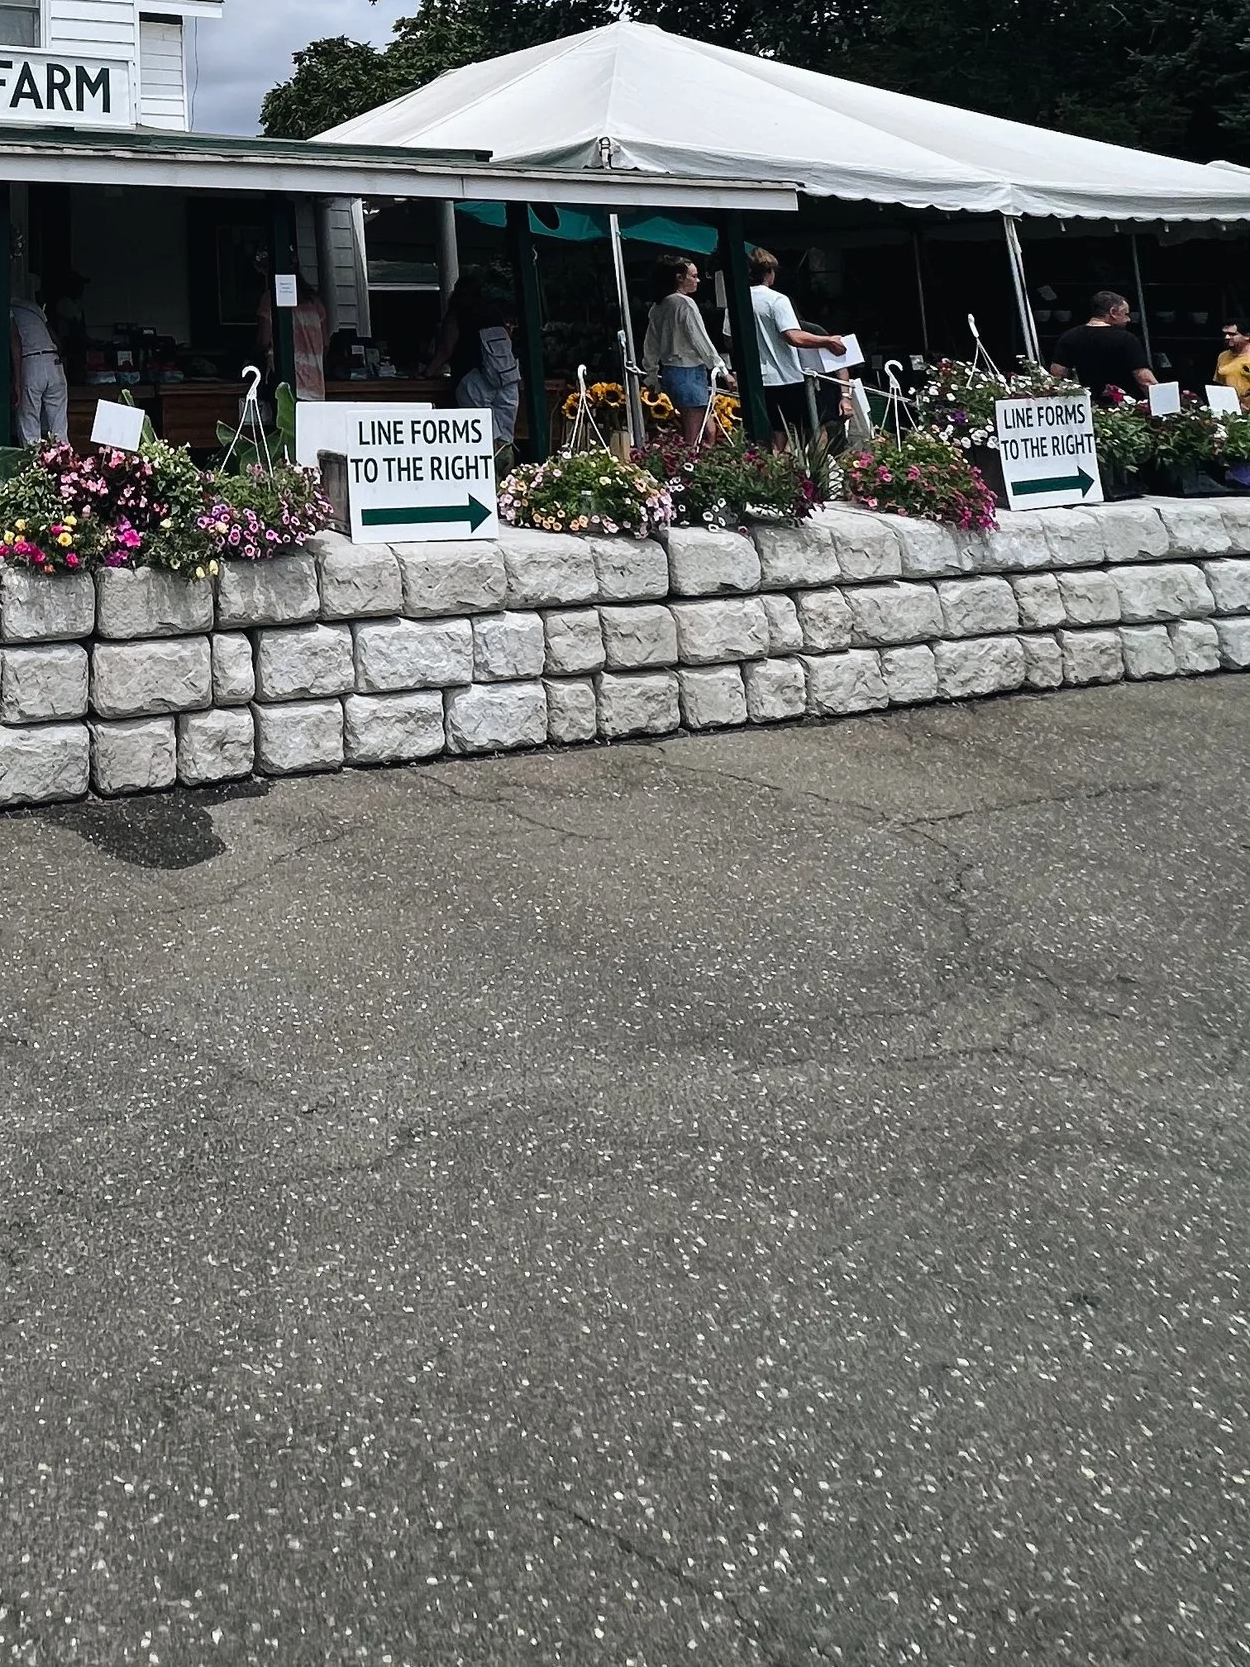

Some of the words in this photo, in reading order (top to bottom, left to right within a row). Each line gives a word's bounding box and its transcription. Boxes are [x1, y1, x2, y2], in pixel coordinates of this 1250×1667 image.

[1004, 407, 1033, 429] LINE
[1037, 404, 1085, 426] FORMS
[358, 421, 404, 445] LINE
[410, 419, 482, 445] FORMS
[1001, 439, 1019, 460] TO
[1021, 437, 1048, 458] THE
[1052, 434, 1093, 456] RIGHT
[350, 457, 378, 483] TO
[382, 457, 424, 482] THE
[430, 455, 492, 481] RIGHT
